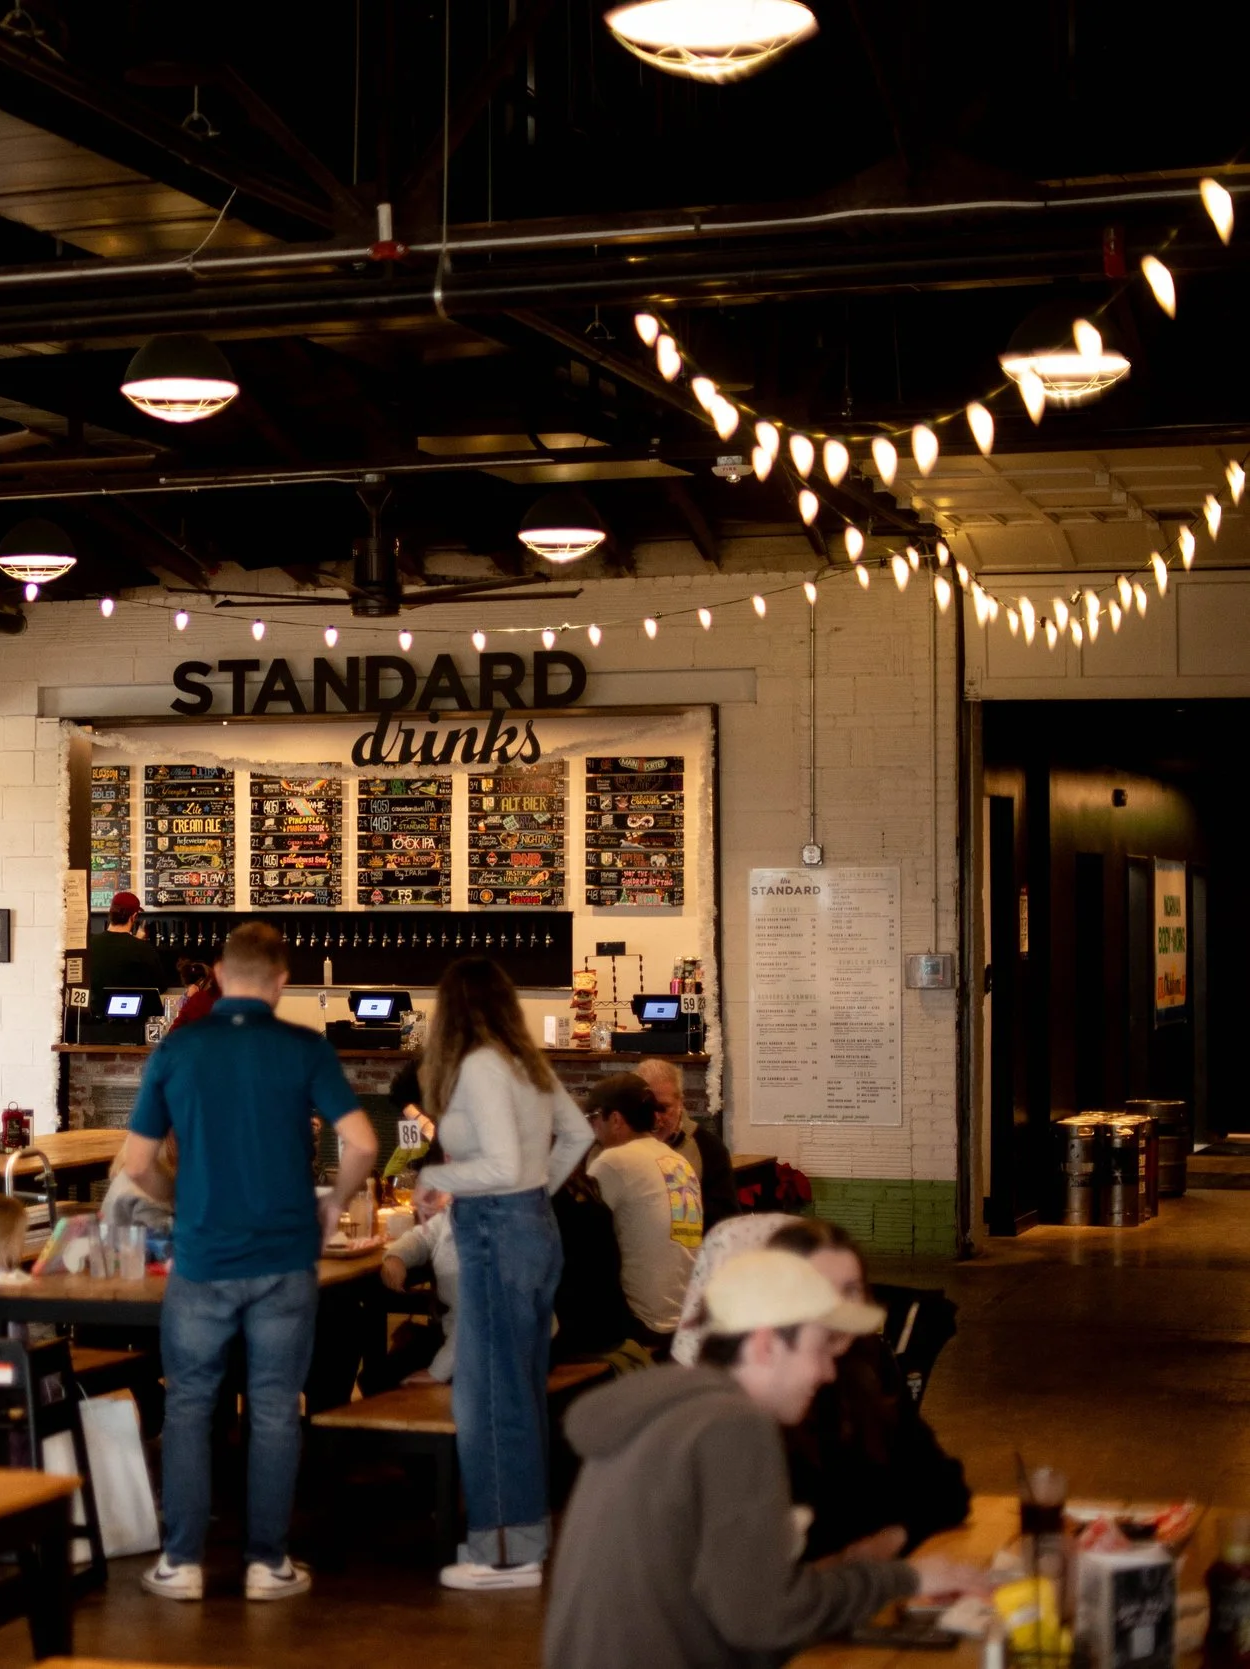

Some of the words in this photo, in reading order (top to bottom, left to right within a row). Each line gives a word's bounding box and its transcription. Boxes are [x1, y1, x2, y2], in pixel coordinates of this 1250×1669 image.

[169, 650, 587, 715] STANDARD
[351, 708, 541, 767] drinks
[621, 758, 638, 768] MAIN
[645, 760, 666, 770] PORTER
[182, 802, 202, 815] Lite
[370, 799, 389, 813] (405)
[523, 796, 547, 811] BIER
[173, 818, 203, 833] CREAM
[205, 818, 222, 832] ALE
[288, 816, 320, 825] PINEAPPLE
[370, 816, 392, 832] (405)
[308, 824, 325, 832] SOUR
[422, 837, 436, 849] IPA
[412, 855, 435, 863] NORRIS
[511, 852, 542, 866] DNR
[200, 873, 225, 884] FLOW
[398, 889, 412, 900] F5
[751, 886, 821, 896] STANDARD
[73, 991, 86, 1003] 28
[683, 999, 695, 1010] 59
[402, 1125, 418, 1144] 86
